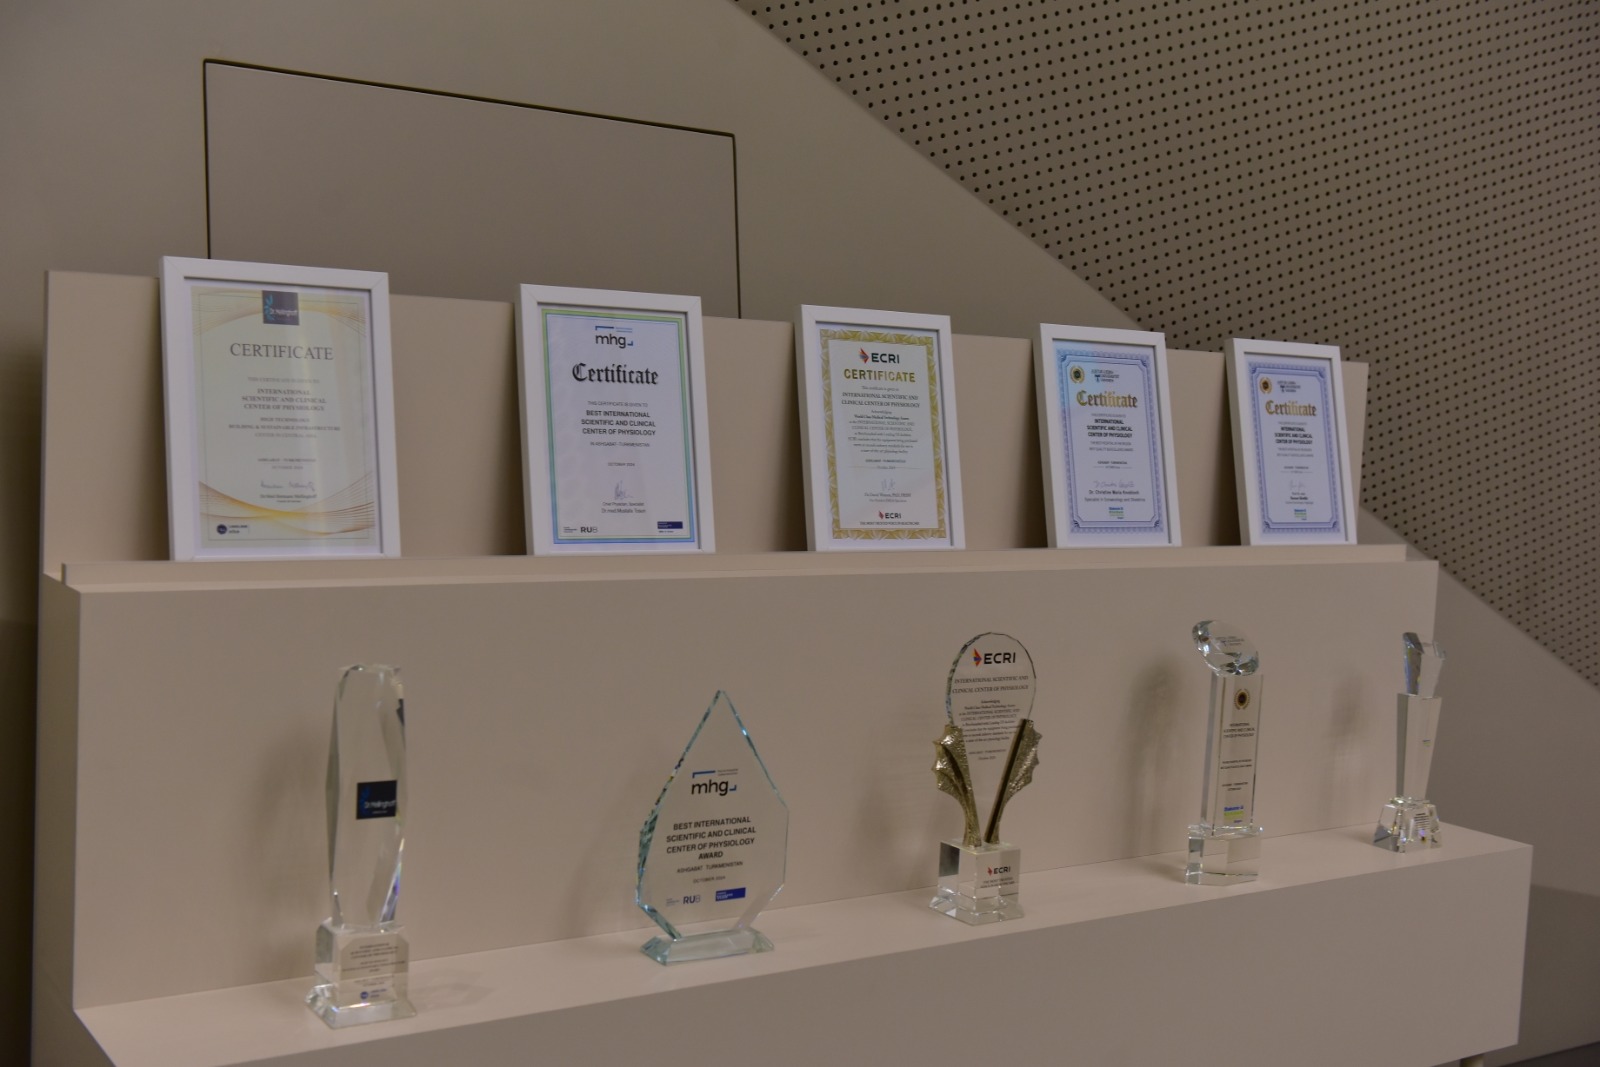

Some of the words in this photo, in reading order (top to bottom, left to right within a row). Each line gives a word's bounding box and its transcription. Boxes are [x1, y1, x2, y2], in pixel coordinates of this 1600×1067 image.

[595, 334, 626, 349] mhg
[229, 342, 335, 361] CERTIFICATE
[871, 352, 900, 364] ECRI
[572, 362, 659, 385] Certificate
[843, 368, 916, 383] CERTIFICATE
[1076, 390, 1138, 408] Certificate
[1265, 400, 1317, 416] Certificate
[984, 652, 1016, 664] ECRI
[691, 779, 729, 796] mhg
[673, 822, 692, 831] BEST
[694, 816, 752, 828] INTERNATIONAL
[666, 831, 706, 843] SCIENTIFIC
[708, 830, 723, 838] AND
[724, 826, 756, 836] CLINICAL
[666, 842, 697, 854] CENTER
[698, 842, 708, 850] OF
[708, 838, 755, 850] PHYSIOLOGY
[698, 851, 724, 860] AWARD
[676, 865, 703, 874] ASHGABAT
[706, 861, 744, 870] TURKMENISTAN
[994, 866, 1011, 875] ECRI
[682, 894, 702, 905] RUB
